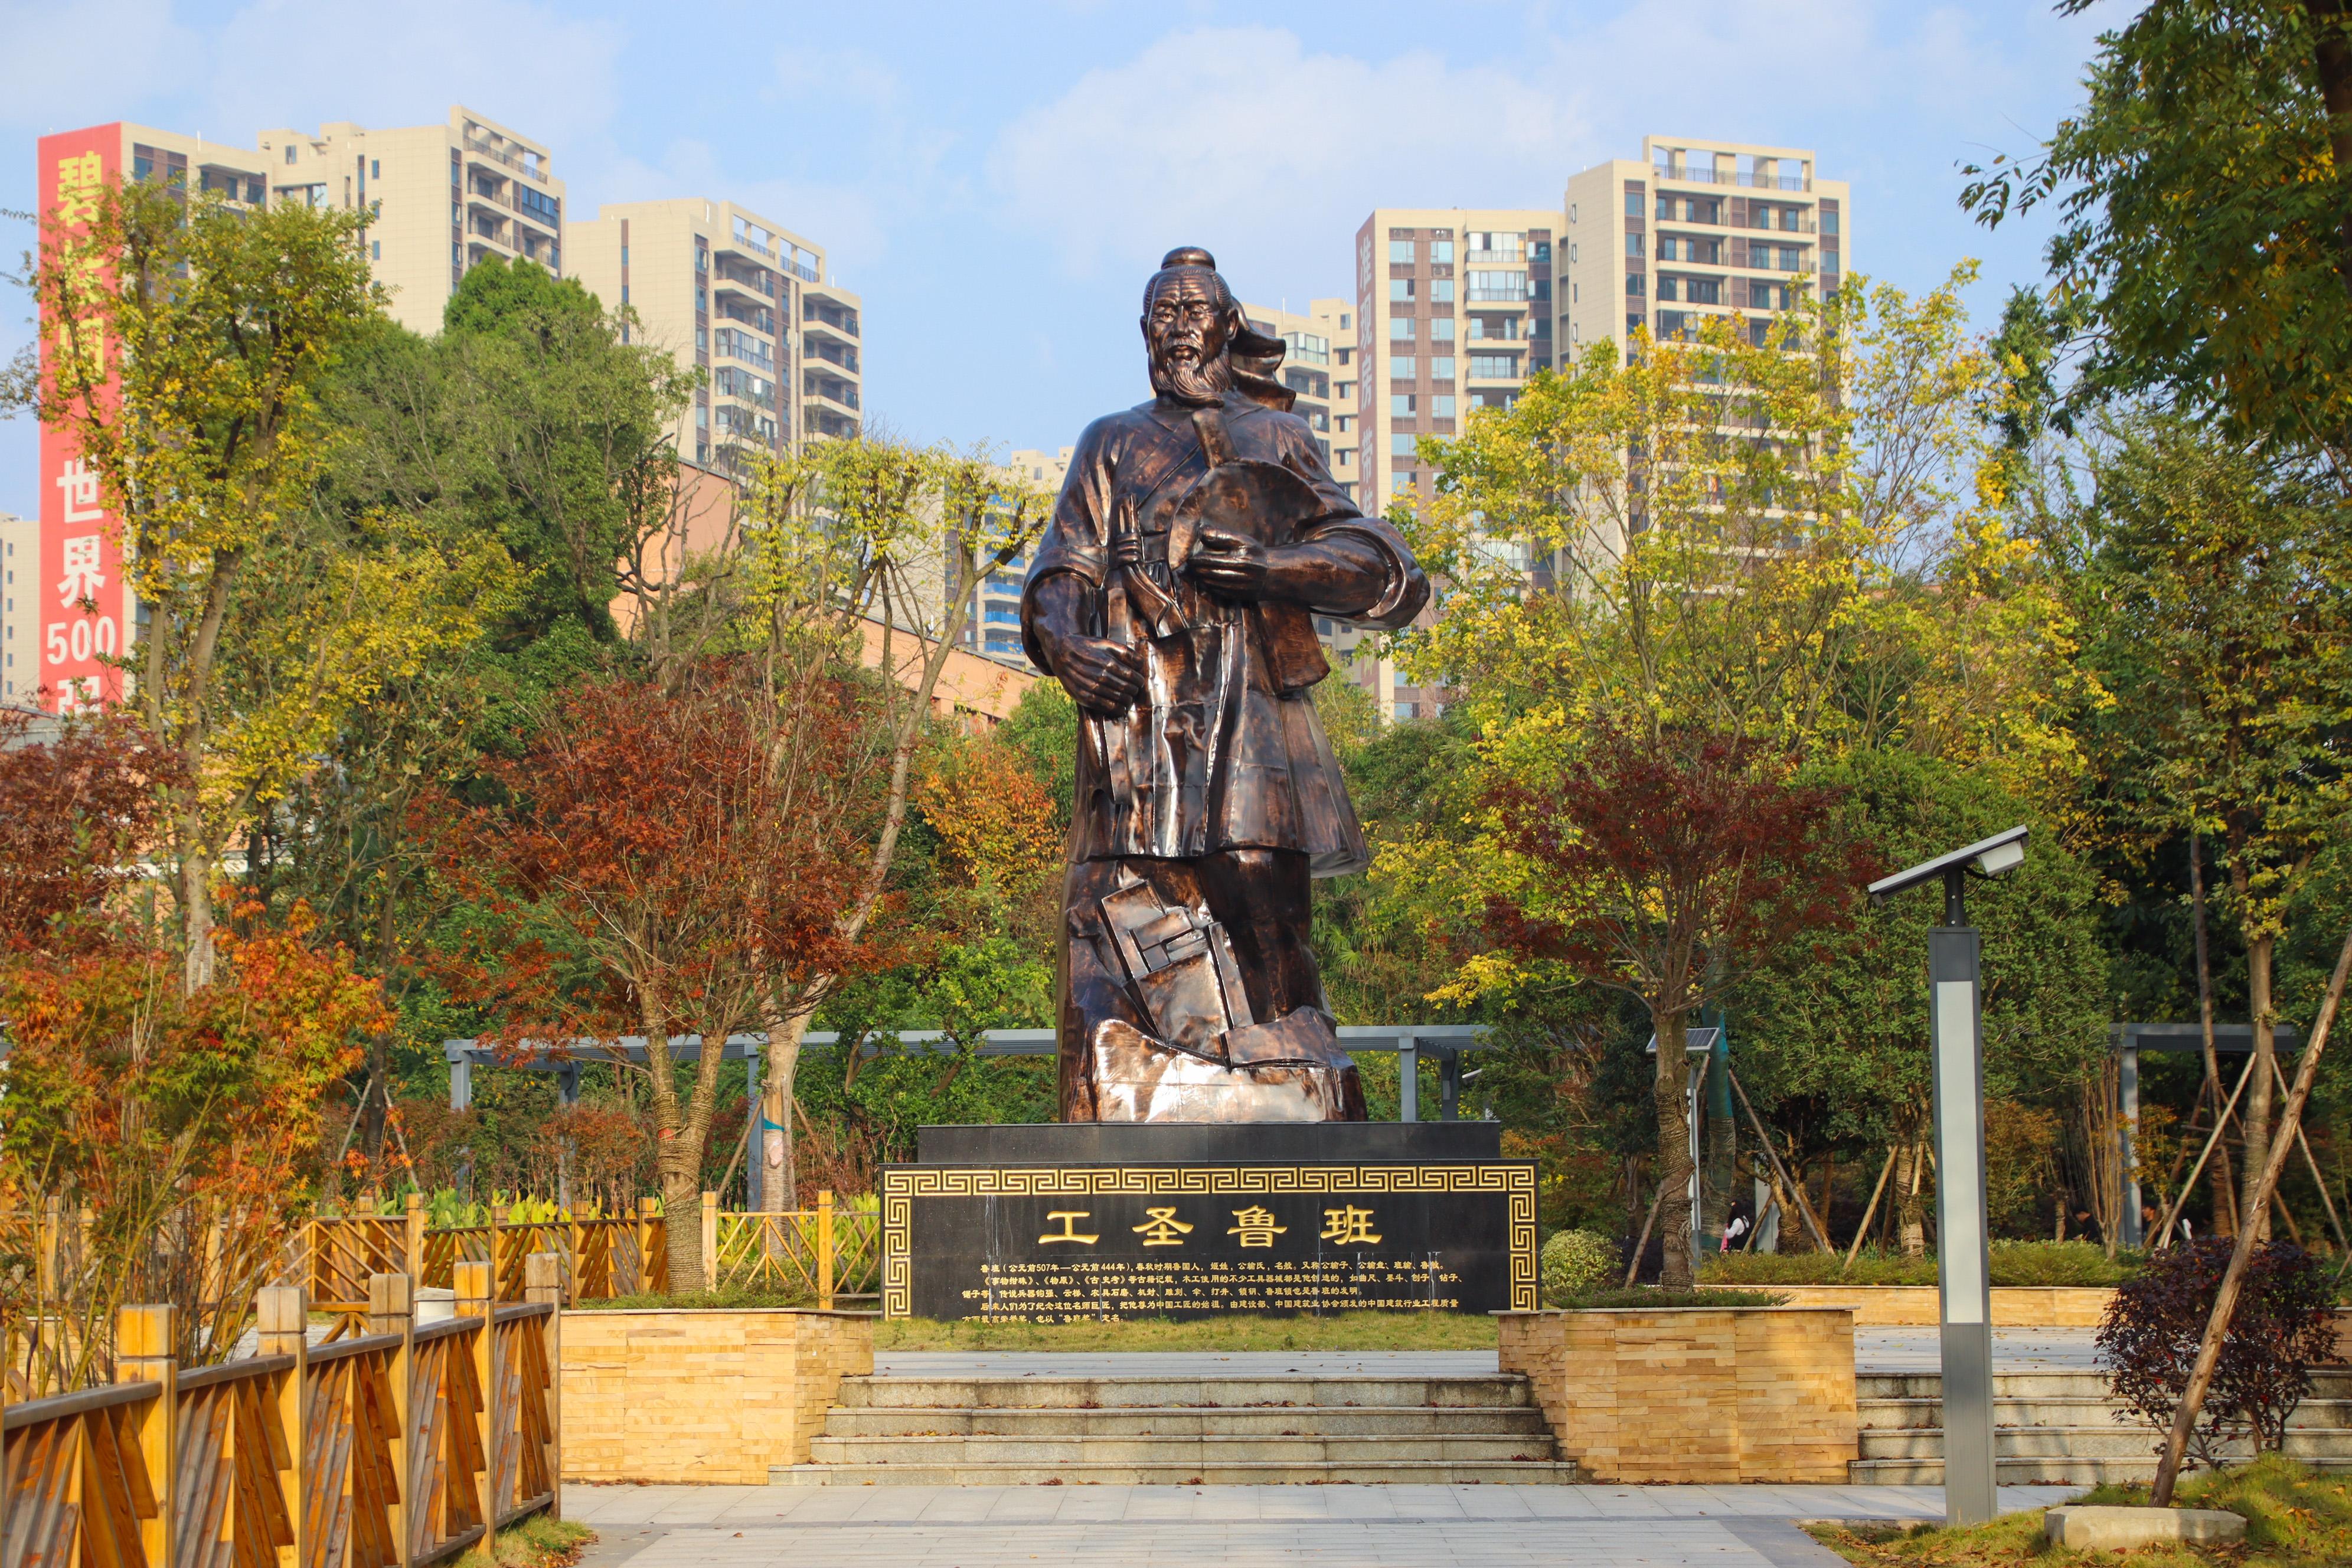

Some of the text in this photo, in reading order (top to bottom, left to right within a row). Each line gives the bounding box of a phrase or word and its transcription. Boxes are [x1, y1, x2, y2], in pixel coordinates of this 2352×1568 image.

[1360, 234, 1373, 411] 准现房
[1038, 1204, 1382, 1247] 工圣鲁班
